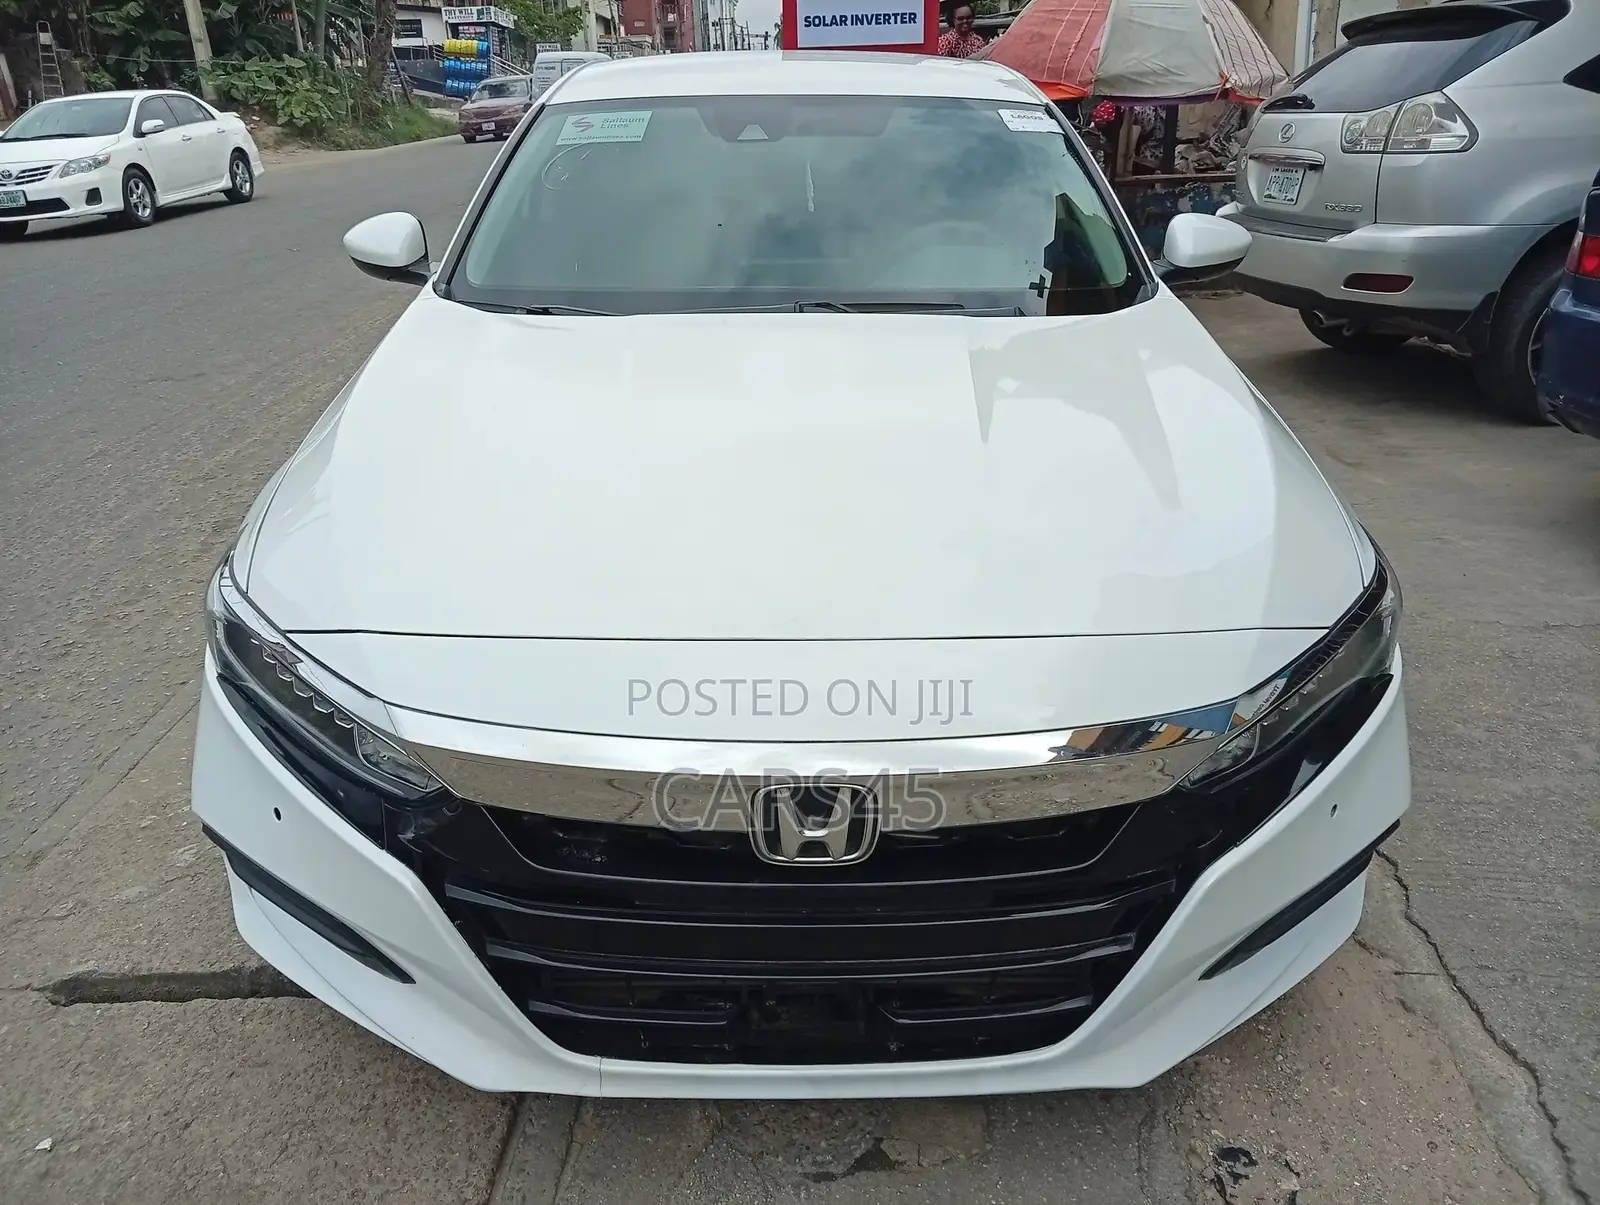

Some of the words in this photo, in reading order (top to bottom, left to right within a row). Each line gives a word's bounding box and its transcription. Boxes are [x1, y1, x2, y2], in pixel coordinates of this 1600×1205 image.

[458, 8, 474, 16] WILL
[803, 14, 849, 28] SOLAR
[850, 12, 917, 26] INVERTER
